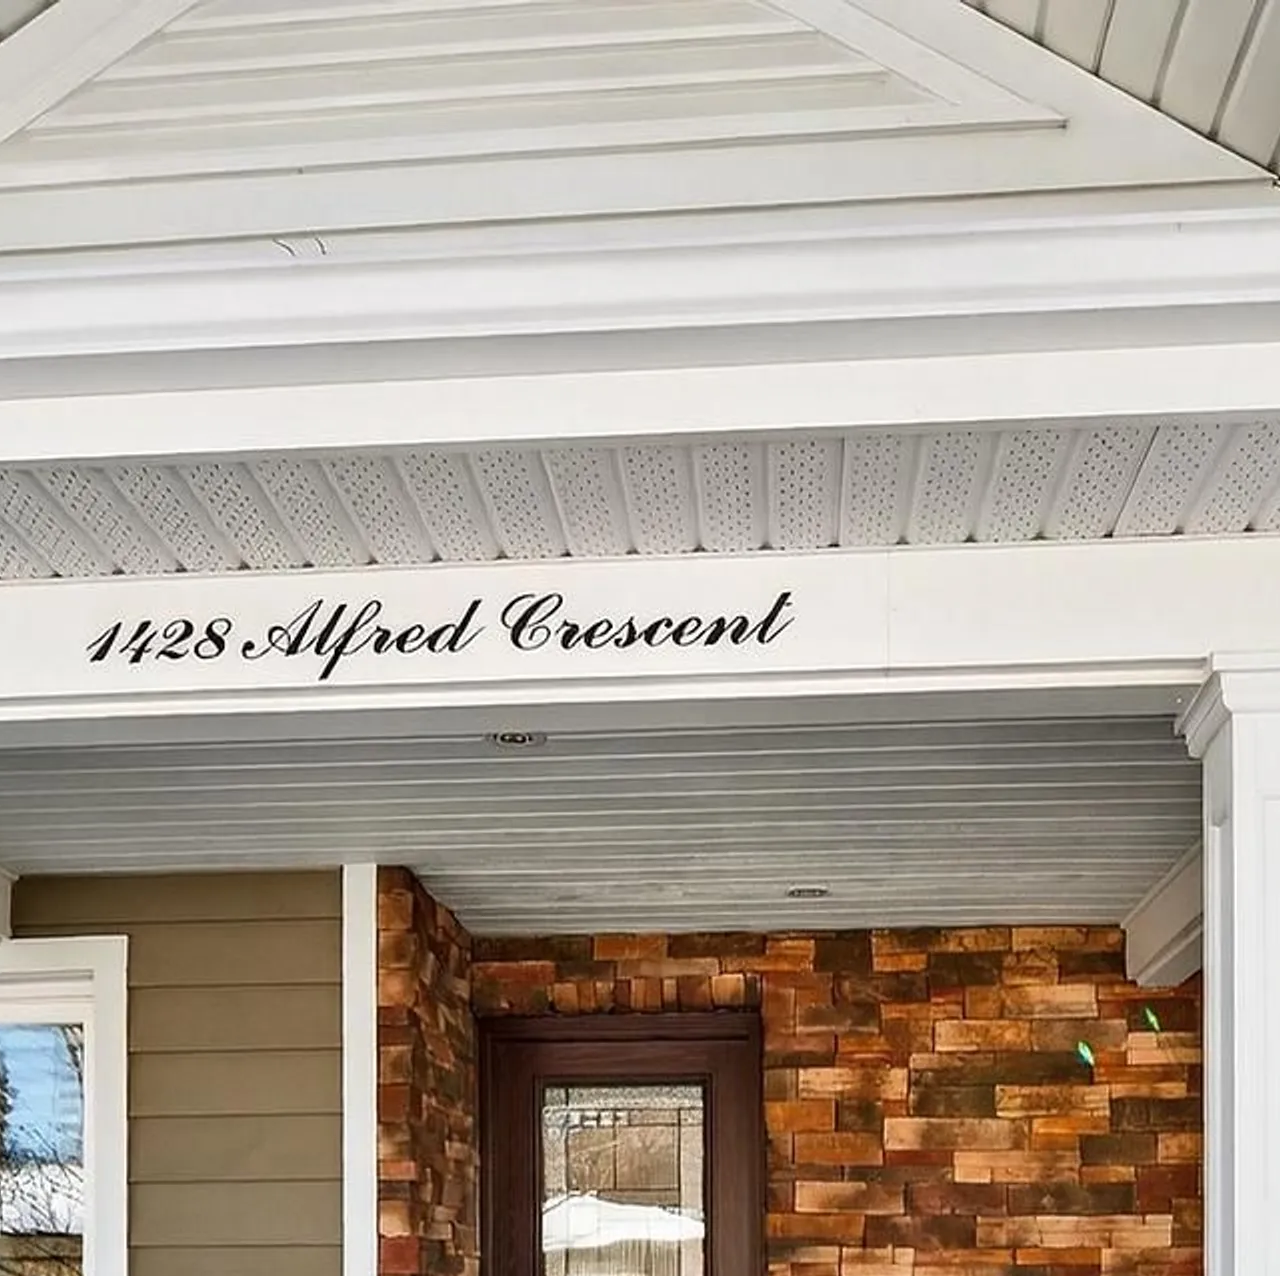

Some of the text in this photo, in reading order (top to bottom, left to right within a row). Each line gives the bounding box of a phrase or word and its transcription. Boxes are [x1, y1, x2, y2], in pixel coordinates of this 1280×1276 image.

[86, 590, 798, 681] 1428 Alfred Crescent
